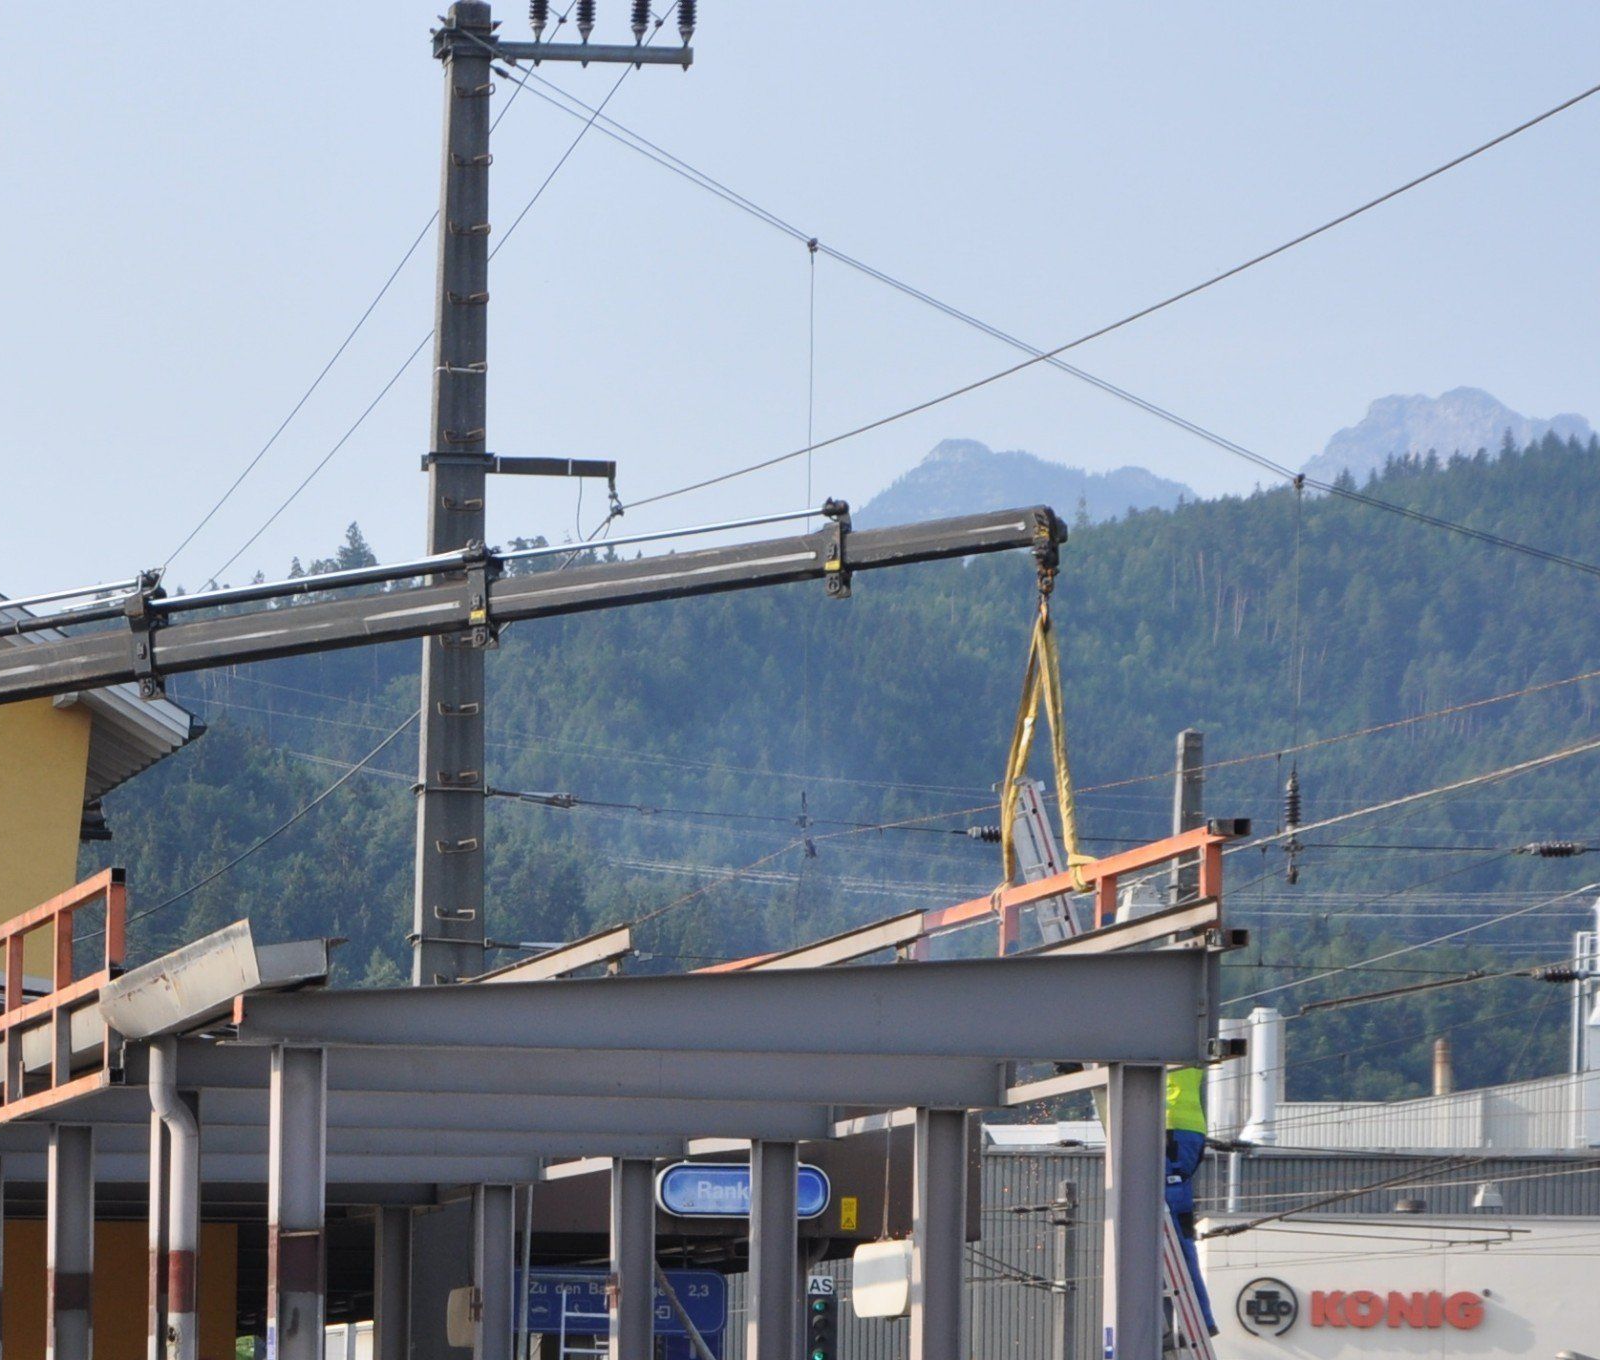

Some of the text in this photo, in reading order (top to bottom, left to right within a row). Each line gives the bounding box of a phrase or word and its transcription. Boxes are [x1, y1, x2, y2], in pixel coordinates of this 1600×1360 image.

[698, 1180, 751, 1201] Rank
[529, 1282, 547, 1295] Zu
[555, 1282, 581, 1295] den
[688, 1284, 709, 1298] 2,3
[810, 1278, 833, 1292] AS
